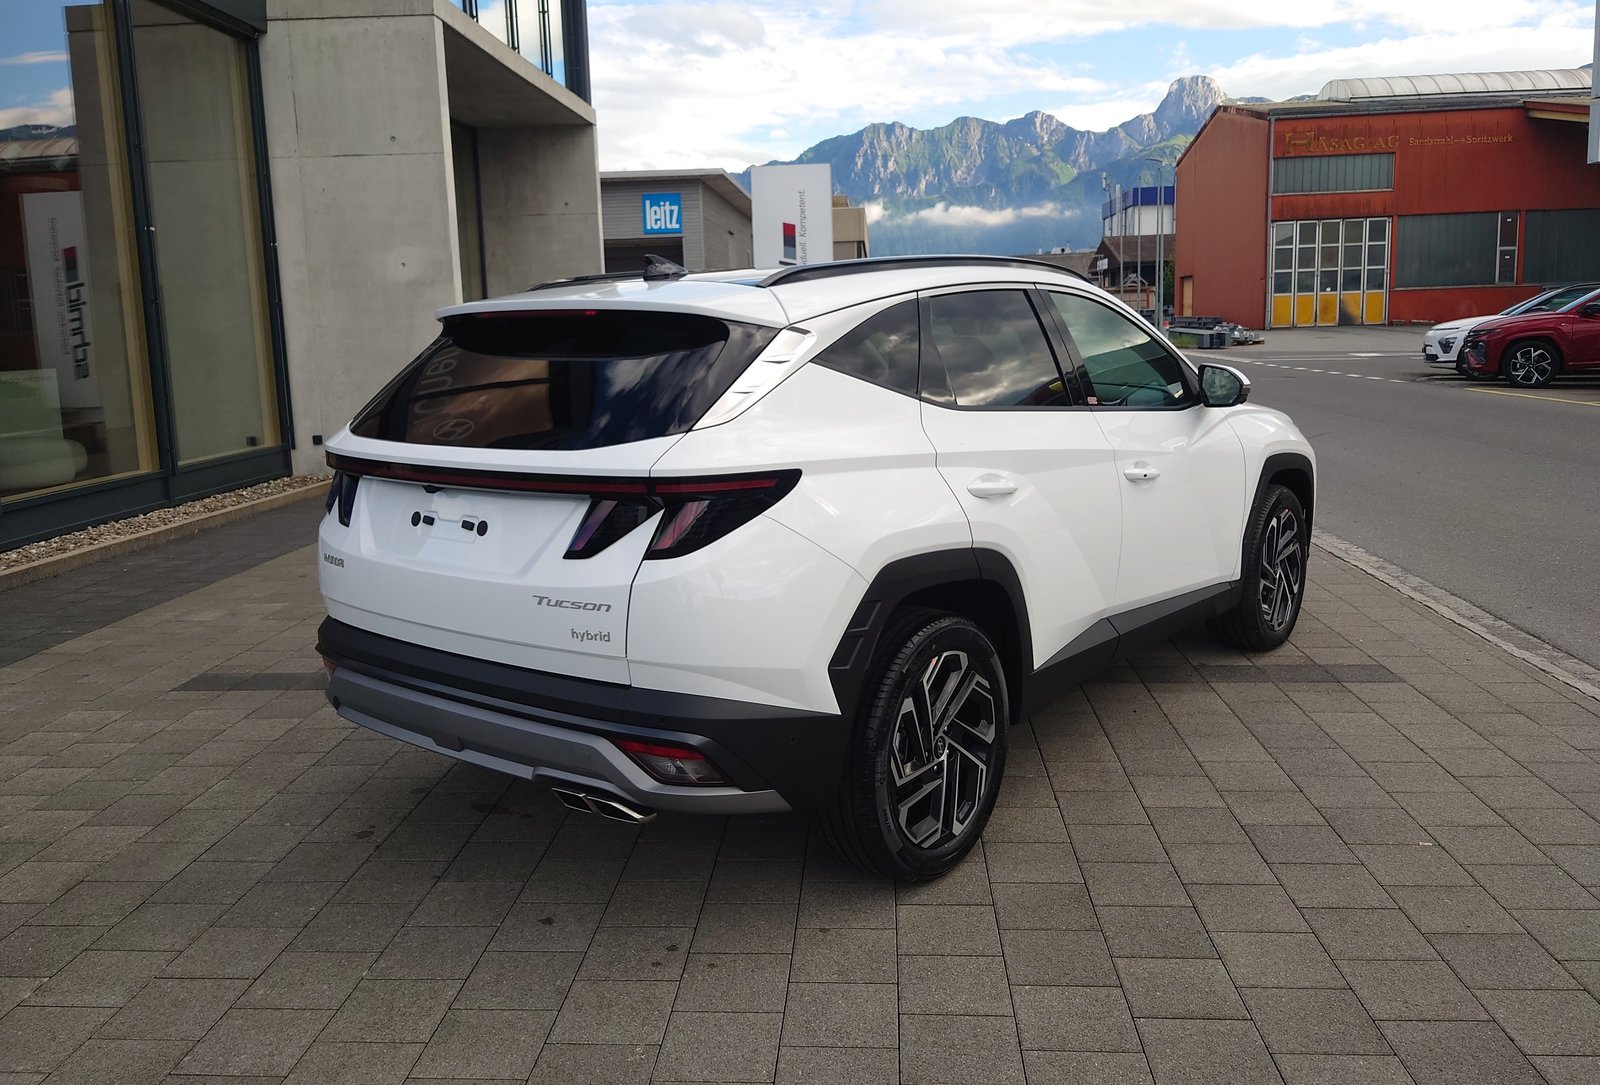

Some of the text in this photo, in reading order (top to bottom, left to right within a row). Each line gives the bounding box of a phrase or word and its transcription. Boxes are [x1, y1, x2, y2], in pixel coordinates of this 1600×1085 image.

[1373, 135, 1400, 149] AG
[645, 200, 680, 229] leitz
[797, 189, 807, 237] Kompetent.
[532, 594, 612, 612] Tucson
[571, 628, 611, 642] hybrid
